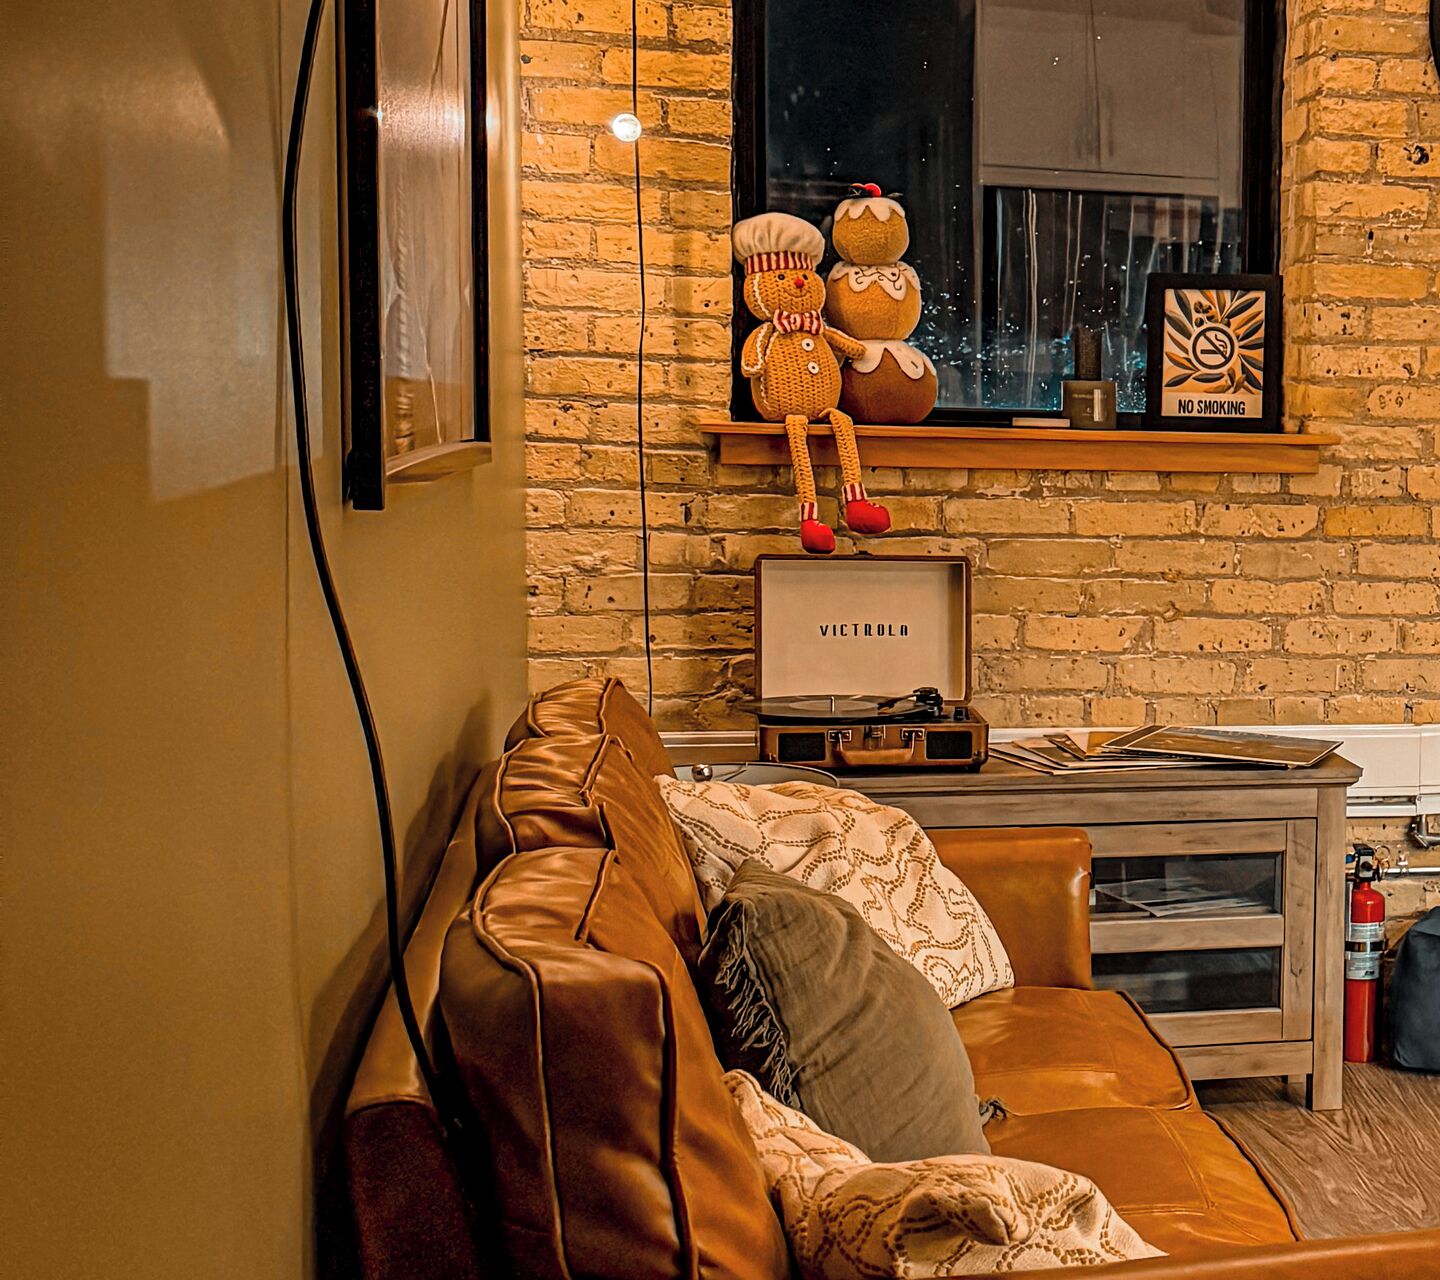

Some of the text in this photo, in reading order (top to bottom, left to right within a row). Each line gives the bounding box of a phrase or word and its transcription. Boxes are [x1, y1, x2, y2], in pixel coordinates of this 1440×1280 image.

[1178, 399, 1246, 415] NO SMOKING
[819, 623, 908, 637] VICTROLA
